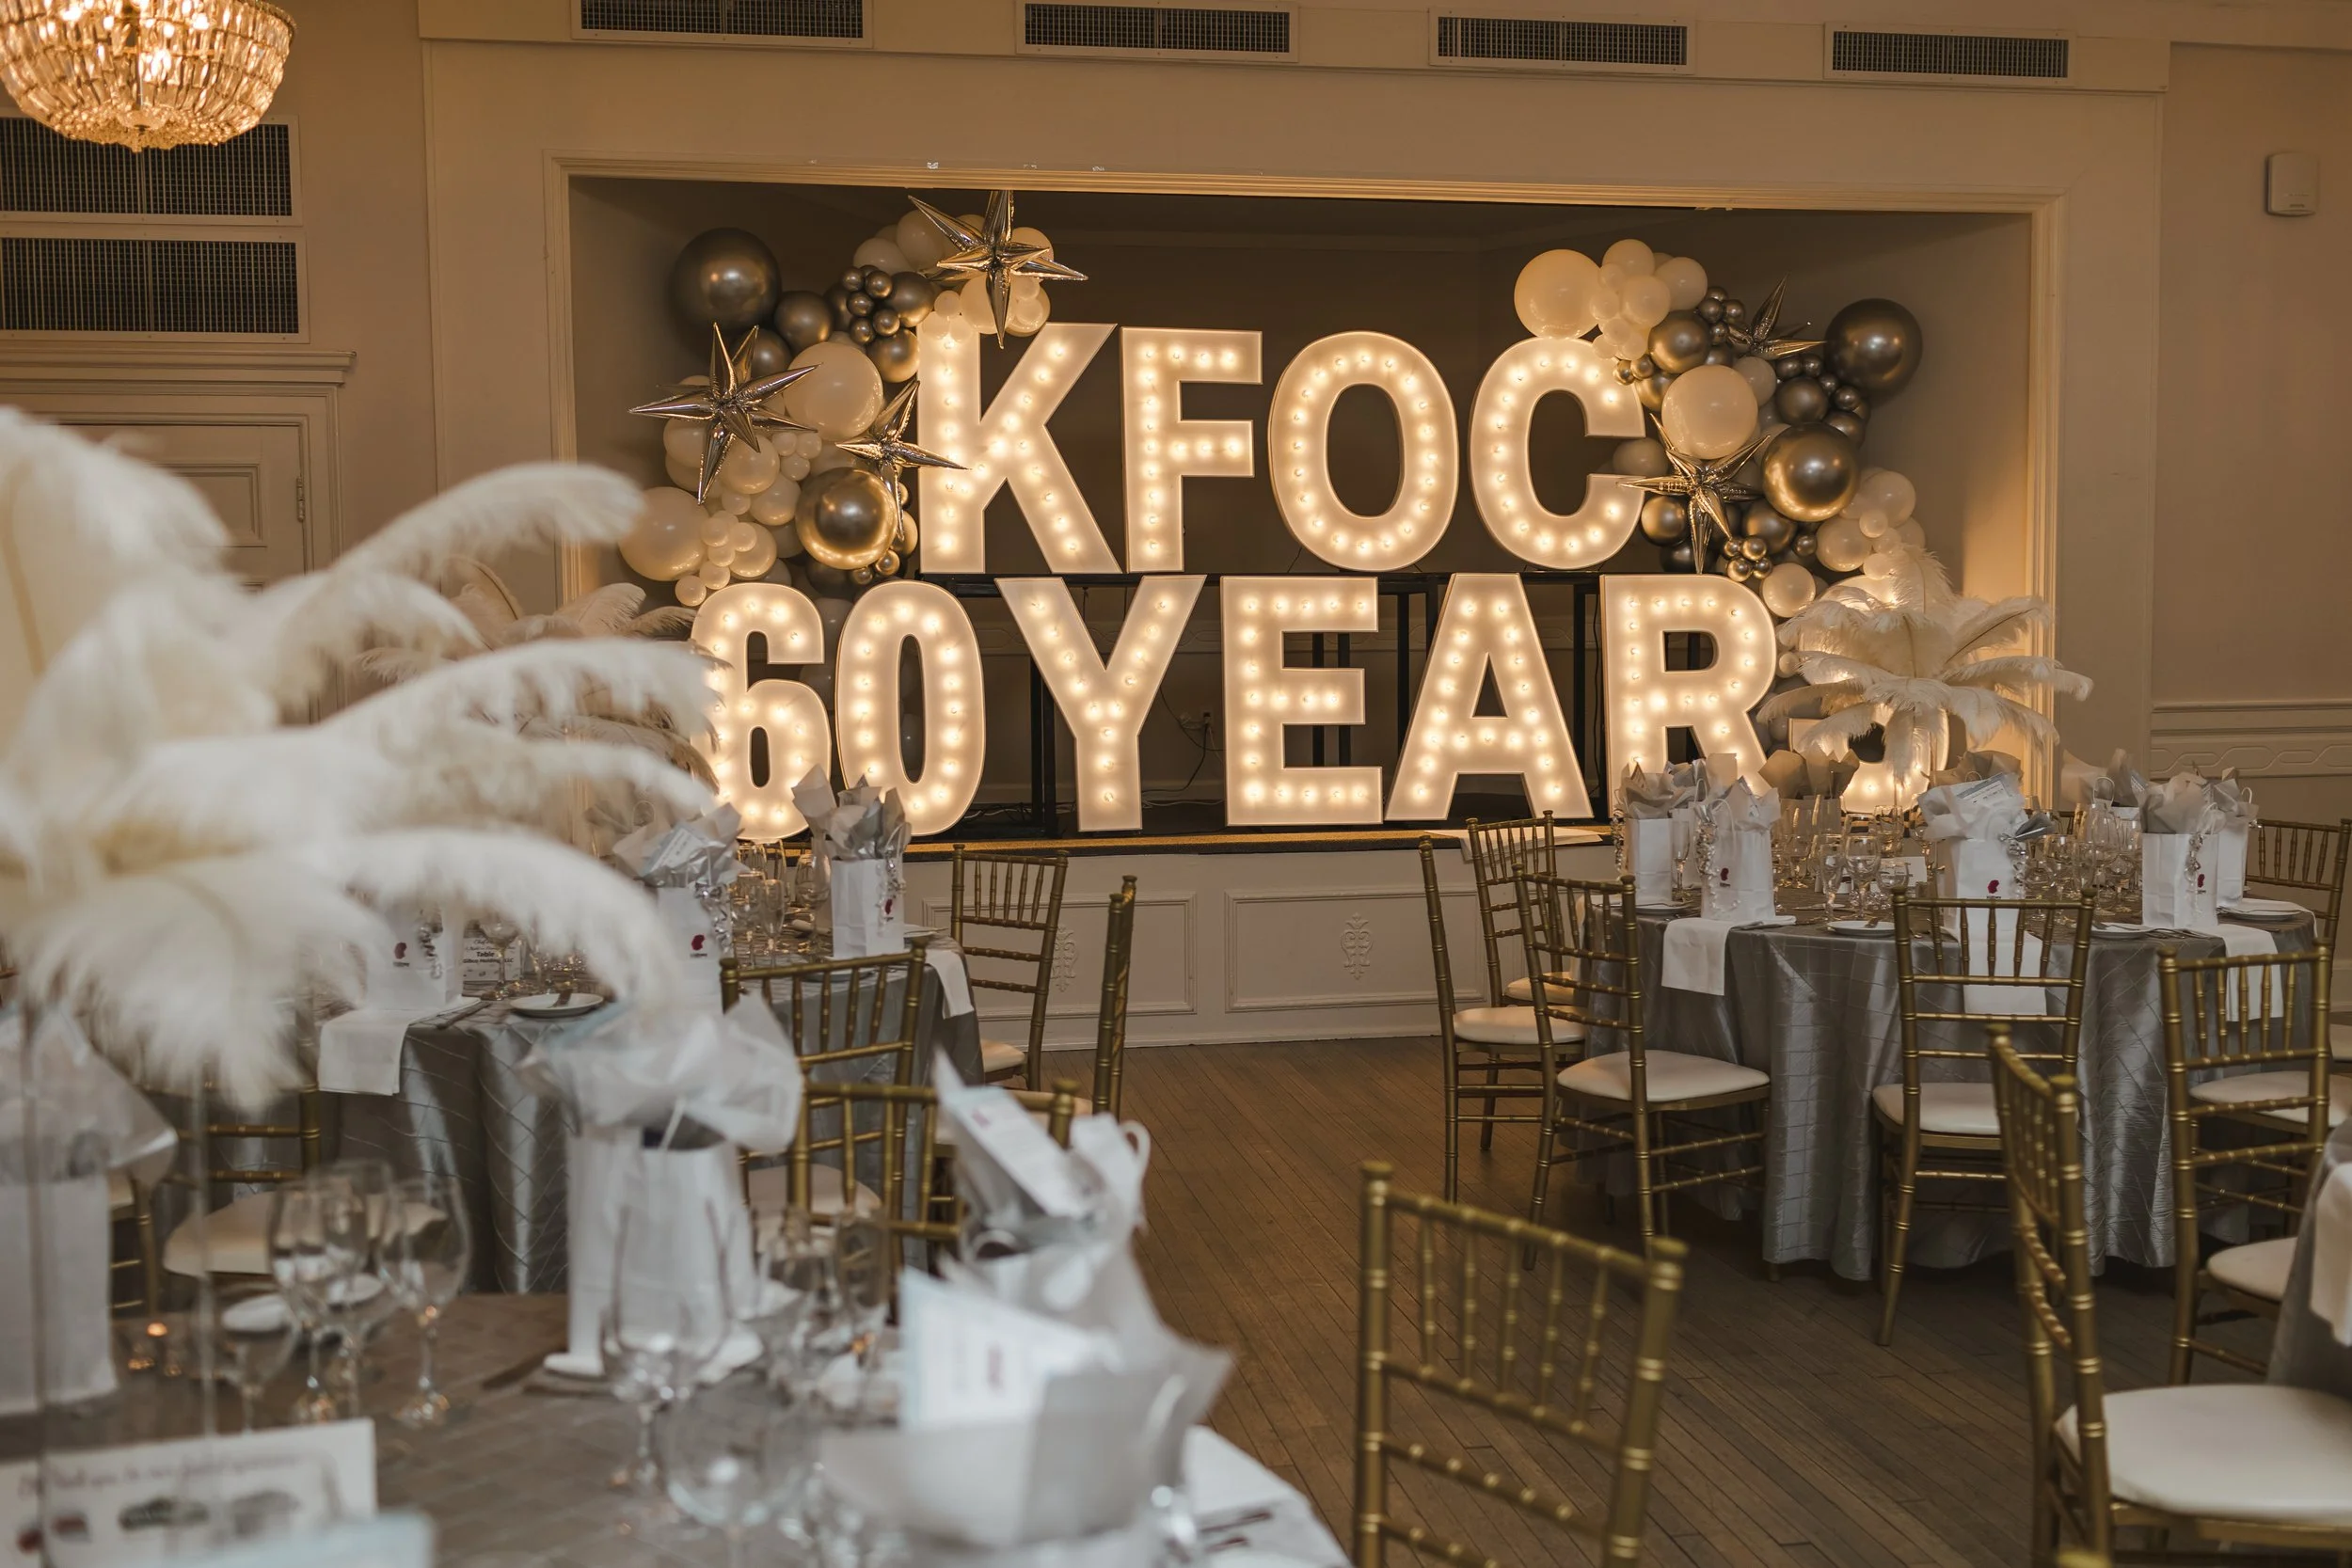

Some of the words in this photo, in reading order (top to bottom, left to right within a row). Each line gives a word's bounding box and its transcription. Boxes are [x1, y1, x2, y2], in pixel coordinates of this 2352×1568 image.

[917, 323, 1645, 575] KFOC
[691, 579, 986, 838] 60
[995, 574, 1951, 832] YEAR
